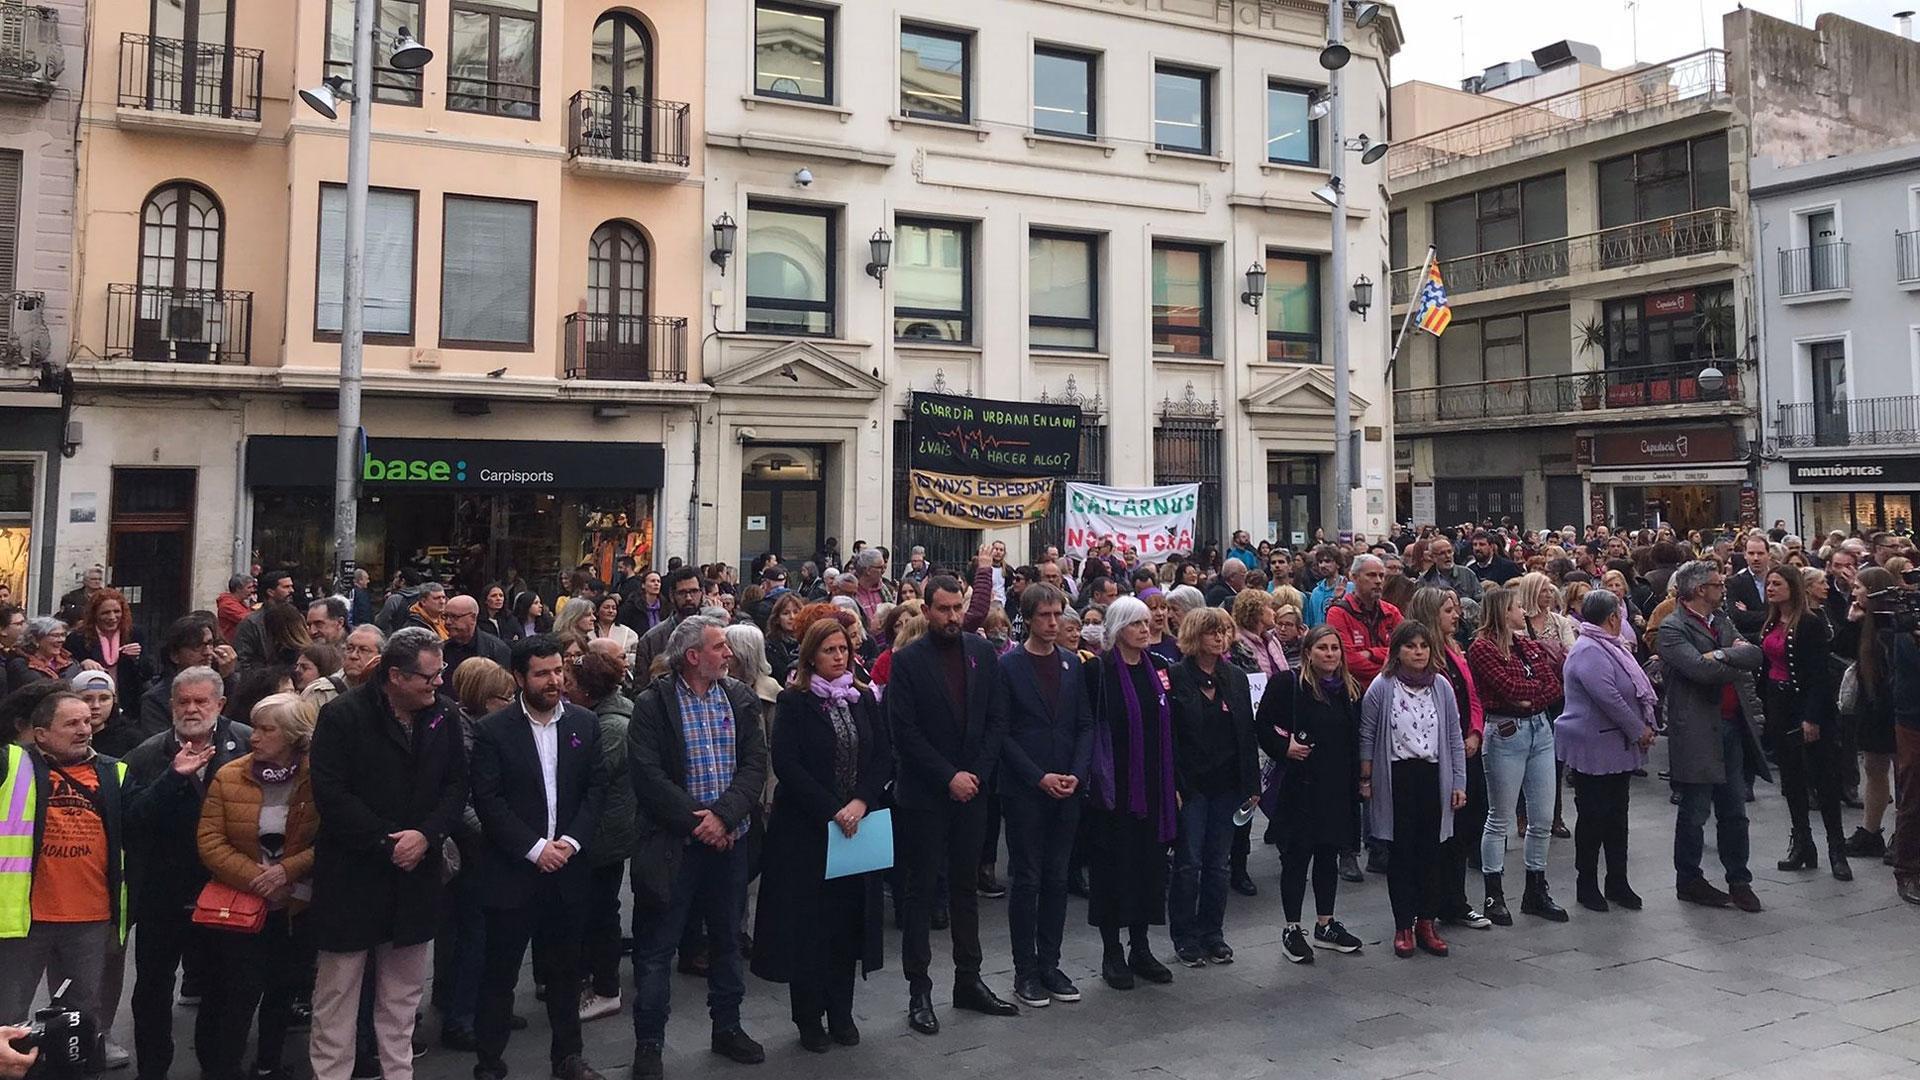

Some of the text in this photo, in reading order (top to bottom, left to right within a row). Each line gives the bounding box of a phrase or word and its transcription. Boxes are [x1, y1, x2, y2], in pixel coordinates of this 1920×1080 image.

[871, 419, 878, 429] 2
[982, 410, 1029, 426] URBANA
[1033, 413, 1047, 427] EN
[1049, 416, 1061, 428] LA
[970, 447, 980, 460] A
[987, 450, 1027, 465] HACER
[1033, 452, 1071, 470] ALGO?
[480, 468, 554, 484] Carpisports
[933, 478, 973, 496] ANYS
[977, 477, 1053, 497] ESPERANT
[913, 496, 1025, 520] ESPAIS DIGNES
